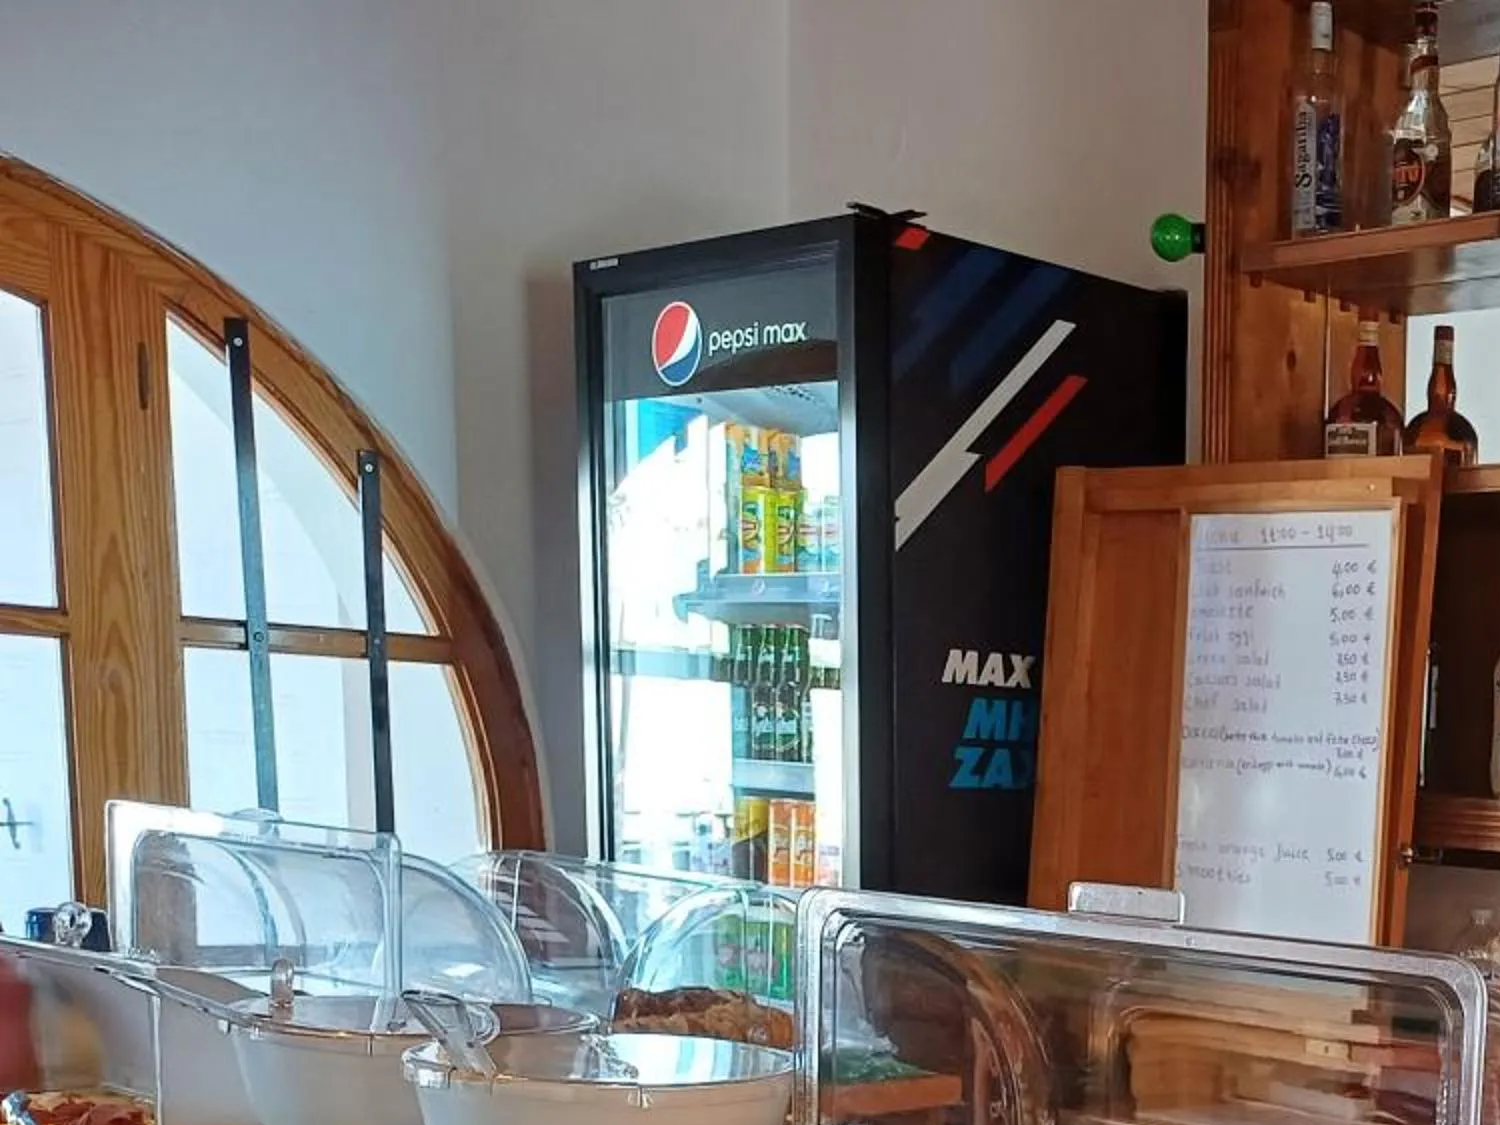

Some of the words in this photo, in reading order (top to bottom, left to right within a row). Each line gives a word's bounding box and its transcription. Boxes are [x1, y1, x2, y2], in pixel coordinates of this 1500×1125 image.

[709, 321, 759, 357] pepsi
[763, 321, 807, 345] max
[941, 649, 1036, 689] MAX
